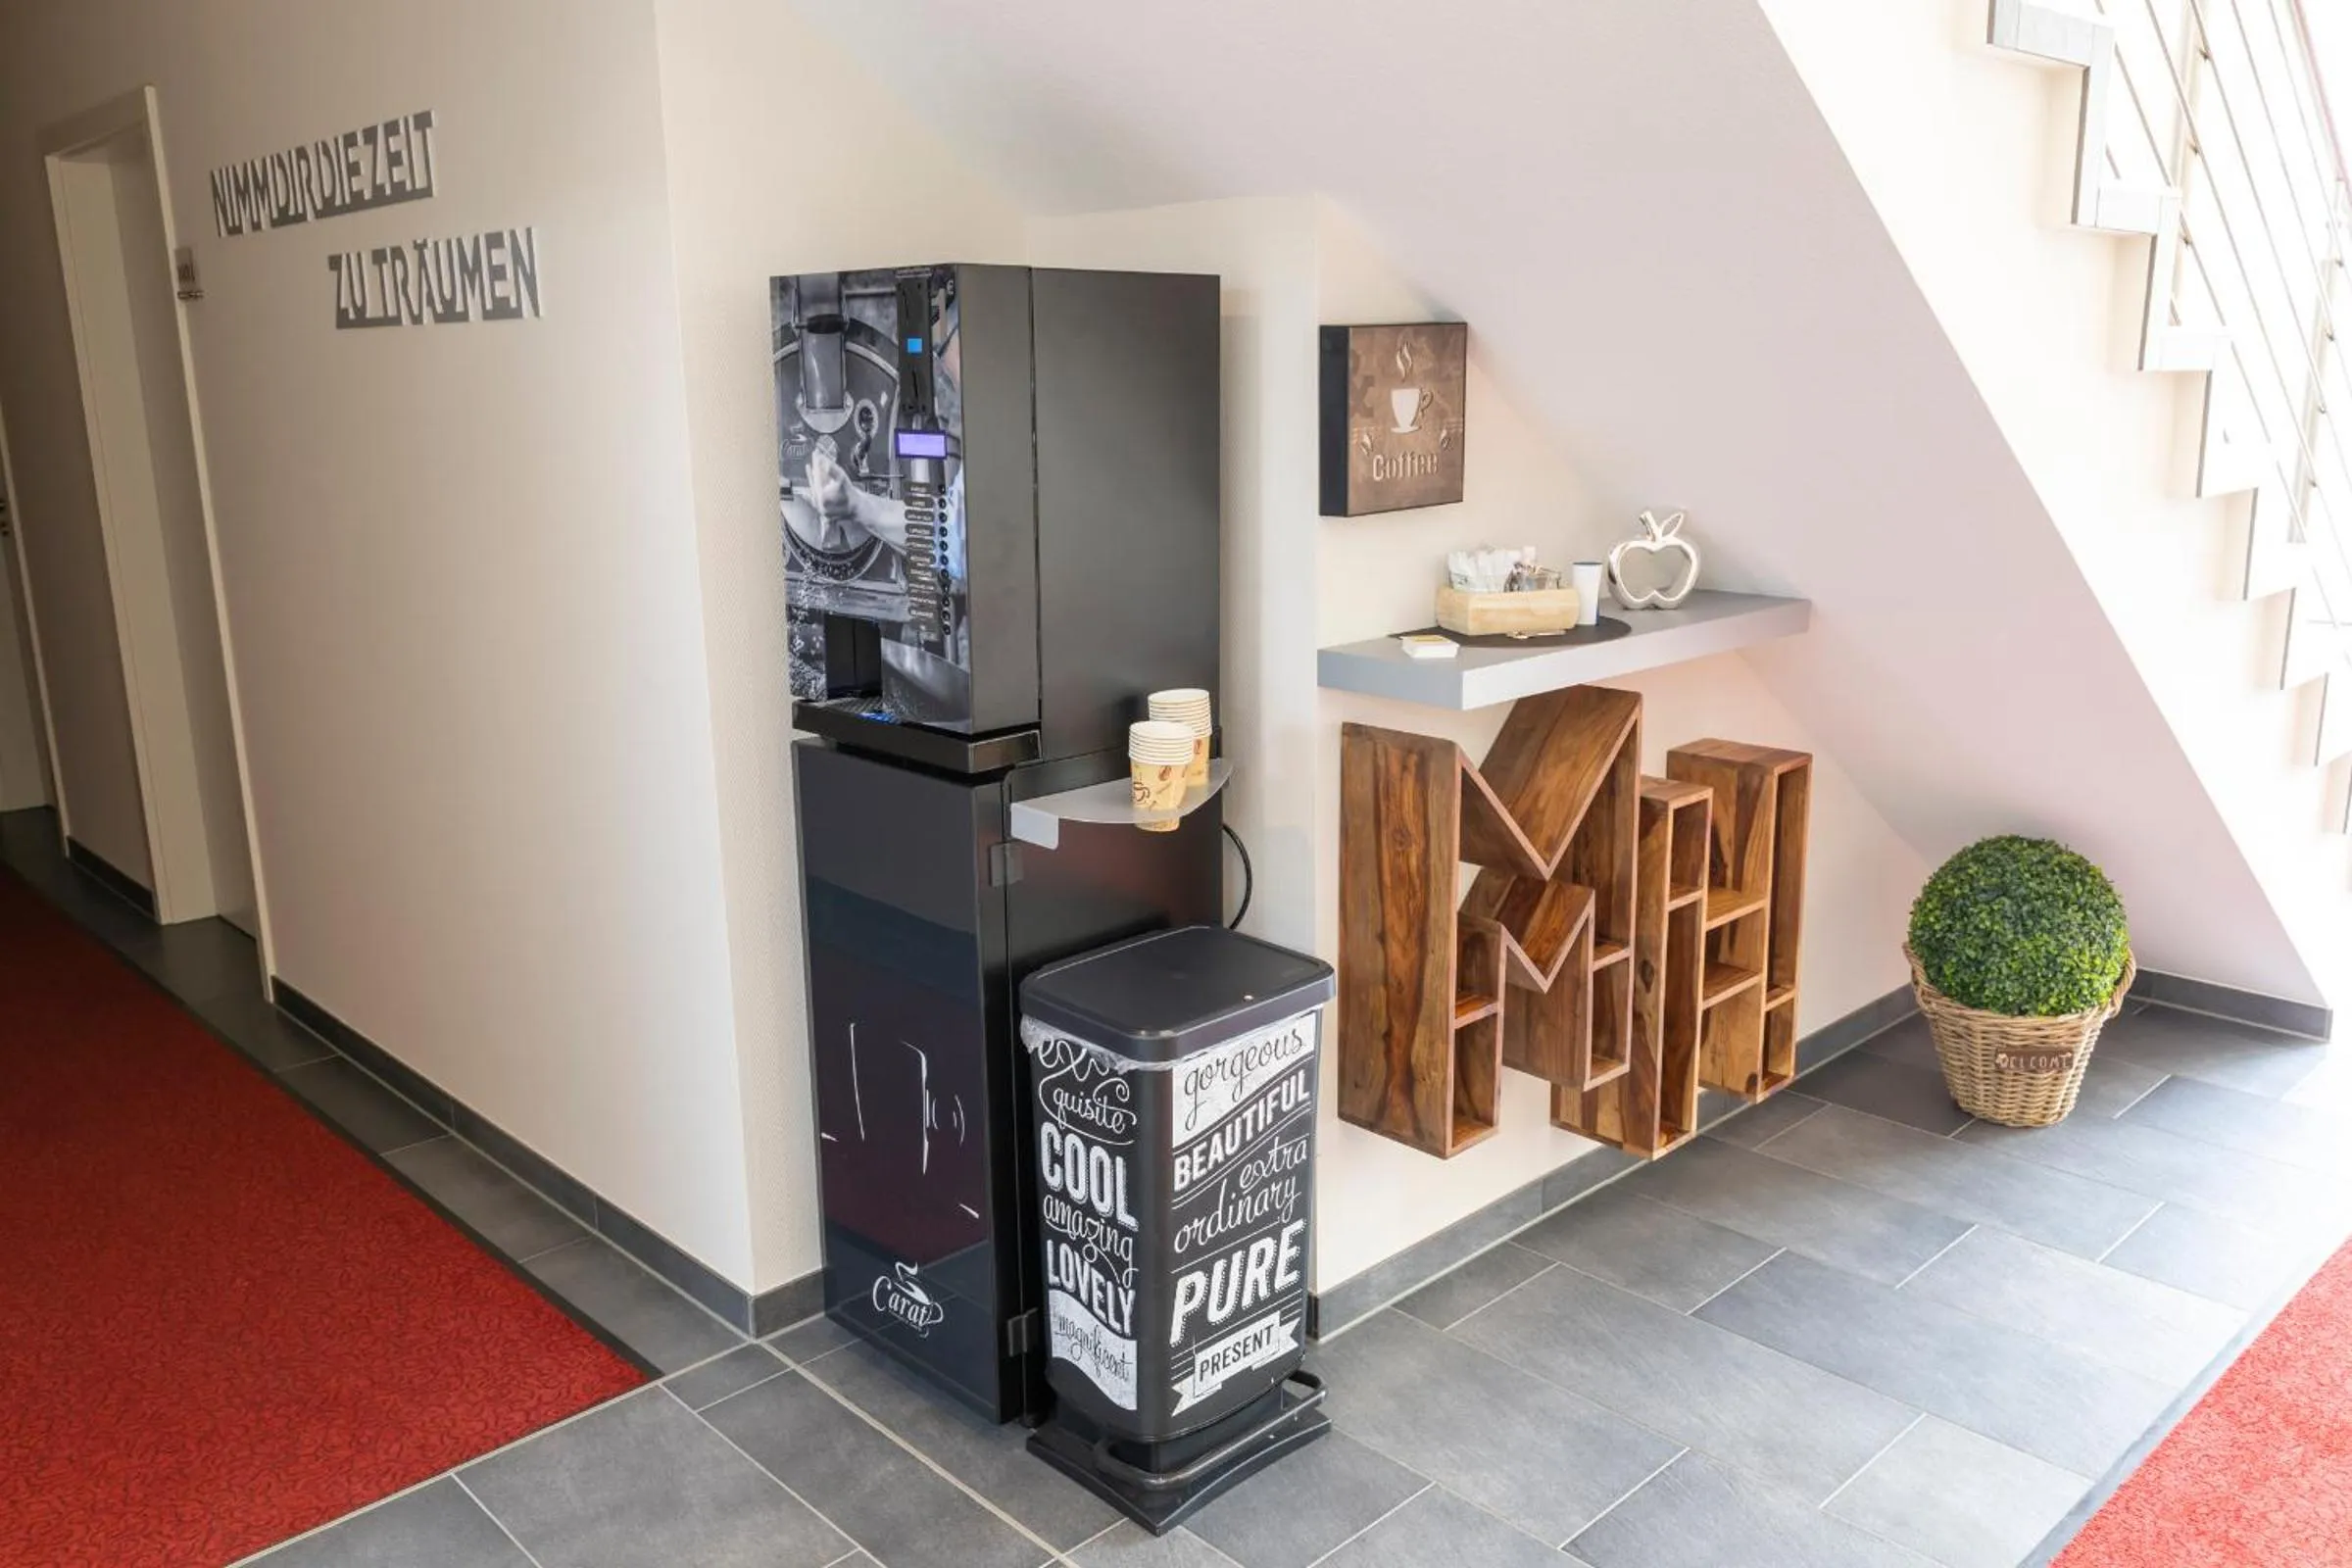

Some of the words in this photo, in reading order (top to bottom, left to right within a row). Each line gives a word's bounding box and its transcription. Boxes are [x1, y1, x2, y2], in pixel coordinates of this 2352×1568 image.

[1373, 452, 1438, 481] Coffee
[1184, 1028, 1303, 1131] gorgeous
[1040, 1121, 1139, 1232] COOL
[1173, 1069, 1310, 1193] BEAUTIFUL
[1240, 1133, 1309, 1190] extra
[1043, 1195, 1139, 1289] amazing
[1174, 1175, 1301, 1253] ordinary
[872, 1275, 931, 1327] Carat
[1047, 1240, 1137, 1338] LOVELY
[1170, 1219, 1307, 1348] PURE
[1198, 1324, 1276, 1382] PRESENT
